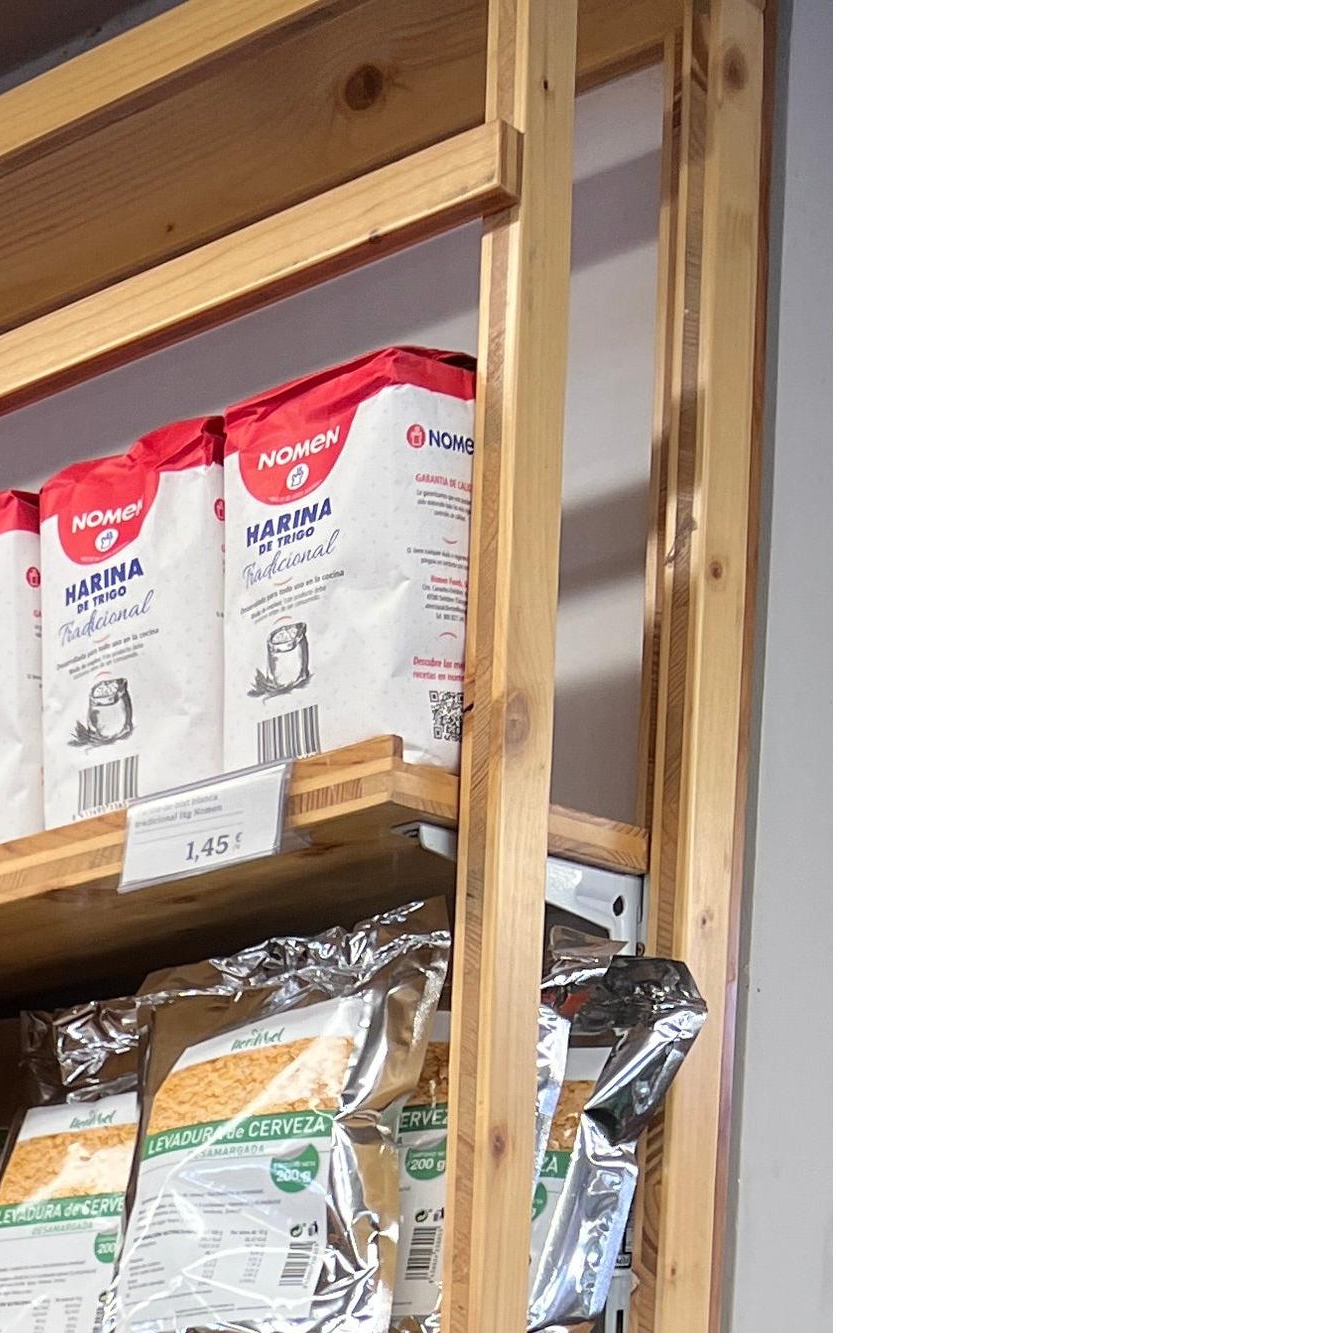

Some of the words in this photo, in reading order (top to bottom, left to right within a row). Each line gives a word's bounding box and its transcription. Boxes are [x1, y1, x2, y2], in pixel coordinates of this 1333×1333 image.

[428, 429, 475, 455] NOMe
[246, 497, 332, 548] HARINA
[243, 528, 340, 588] Tradicional
[258, 542, 273, 556] DE
[277, 527, 315, 551] TRIGO
[65, 558, 143, 606] HARINA
[77, 602, 88, 615] DE
[93, 585, 127, 608] TRIGO
[58, 589, 155, 647] Tradicional
[185, 834, 229, 862] 1,45
[148, 1125, 224, 1155] LEVADURA
[227, 1126, 244, 1139] de
[248, 1116, 326, 1137] CERVEZA
[409, 1158, 434, 1171] 200
